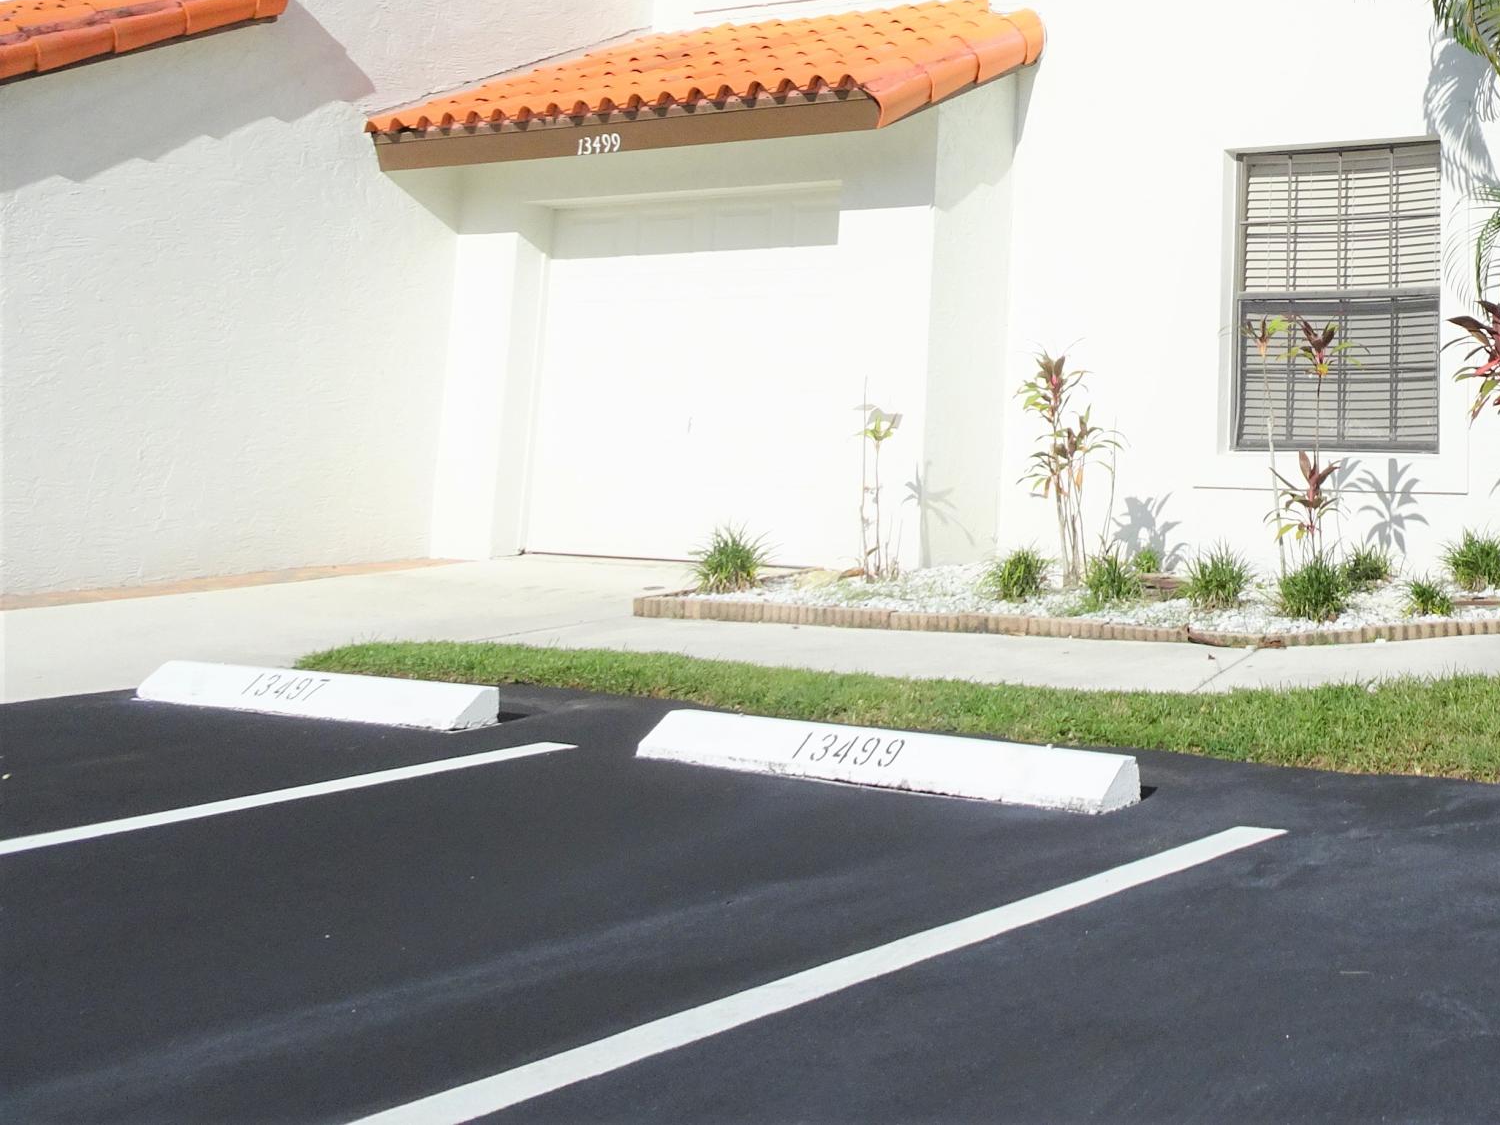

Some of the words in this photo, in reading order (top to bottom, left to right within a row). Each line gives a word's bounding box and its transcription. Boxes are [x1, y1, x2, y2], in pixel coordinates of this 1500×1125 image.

[577, 133, 621, 155] 13499
[241, 673, 331, 701] 13497
[791, 731, 906, 767] 13499
